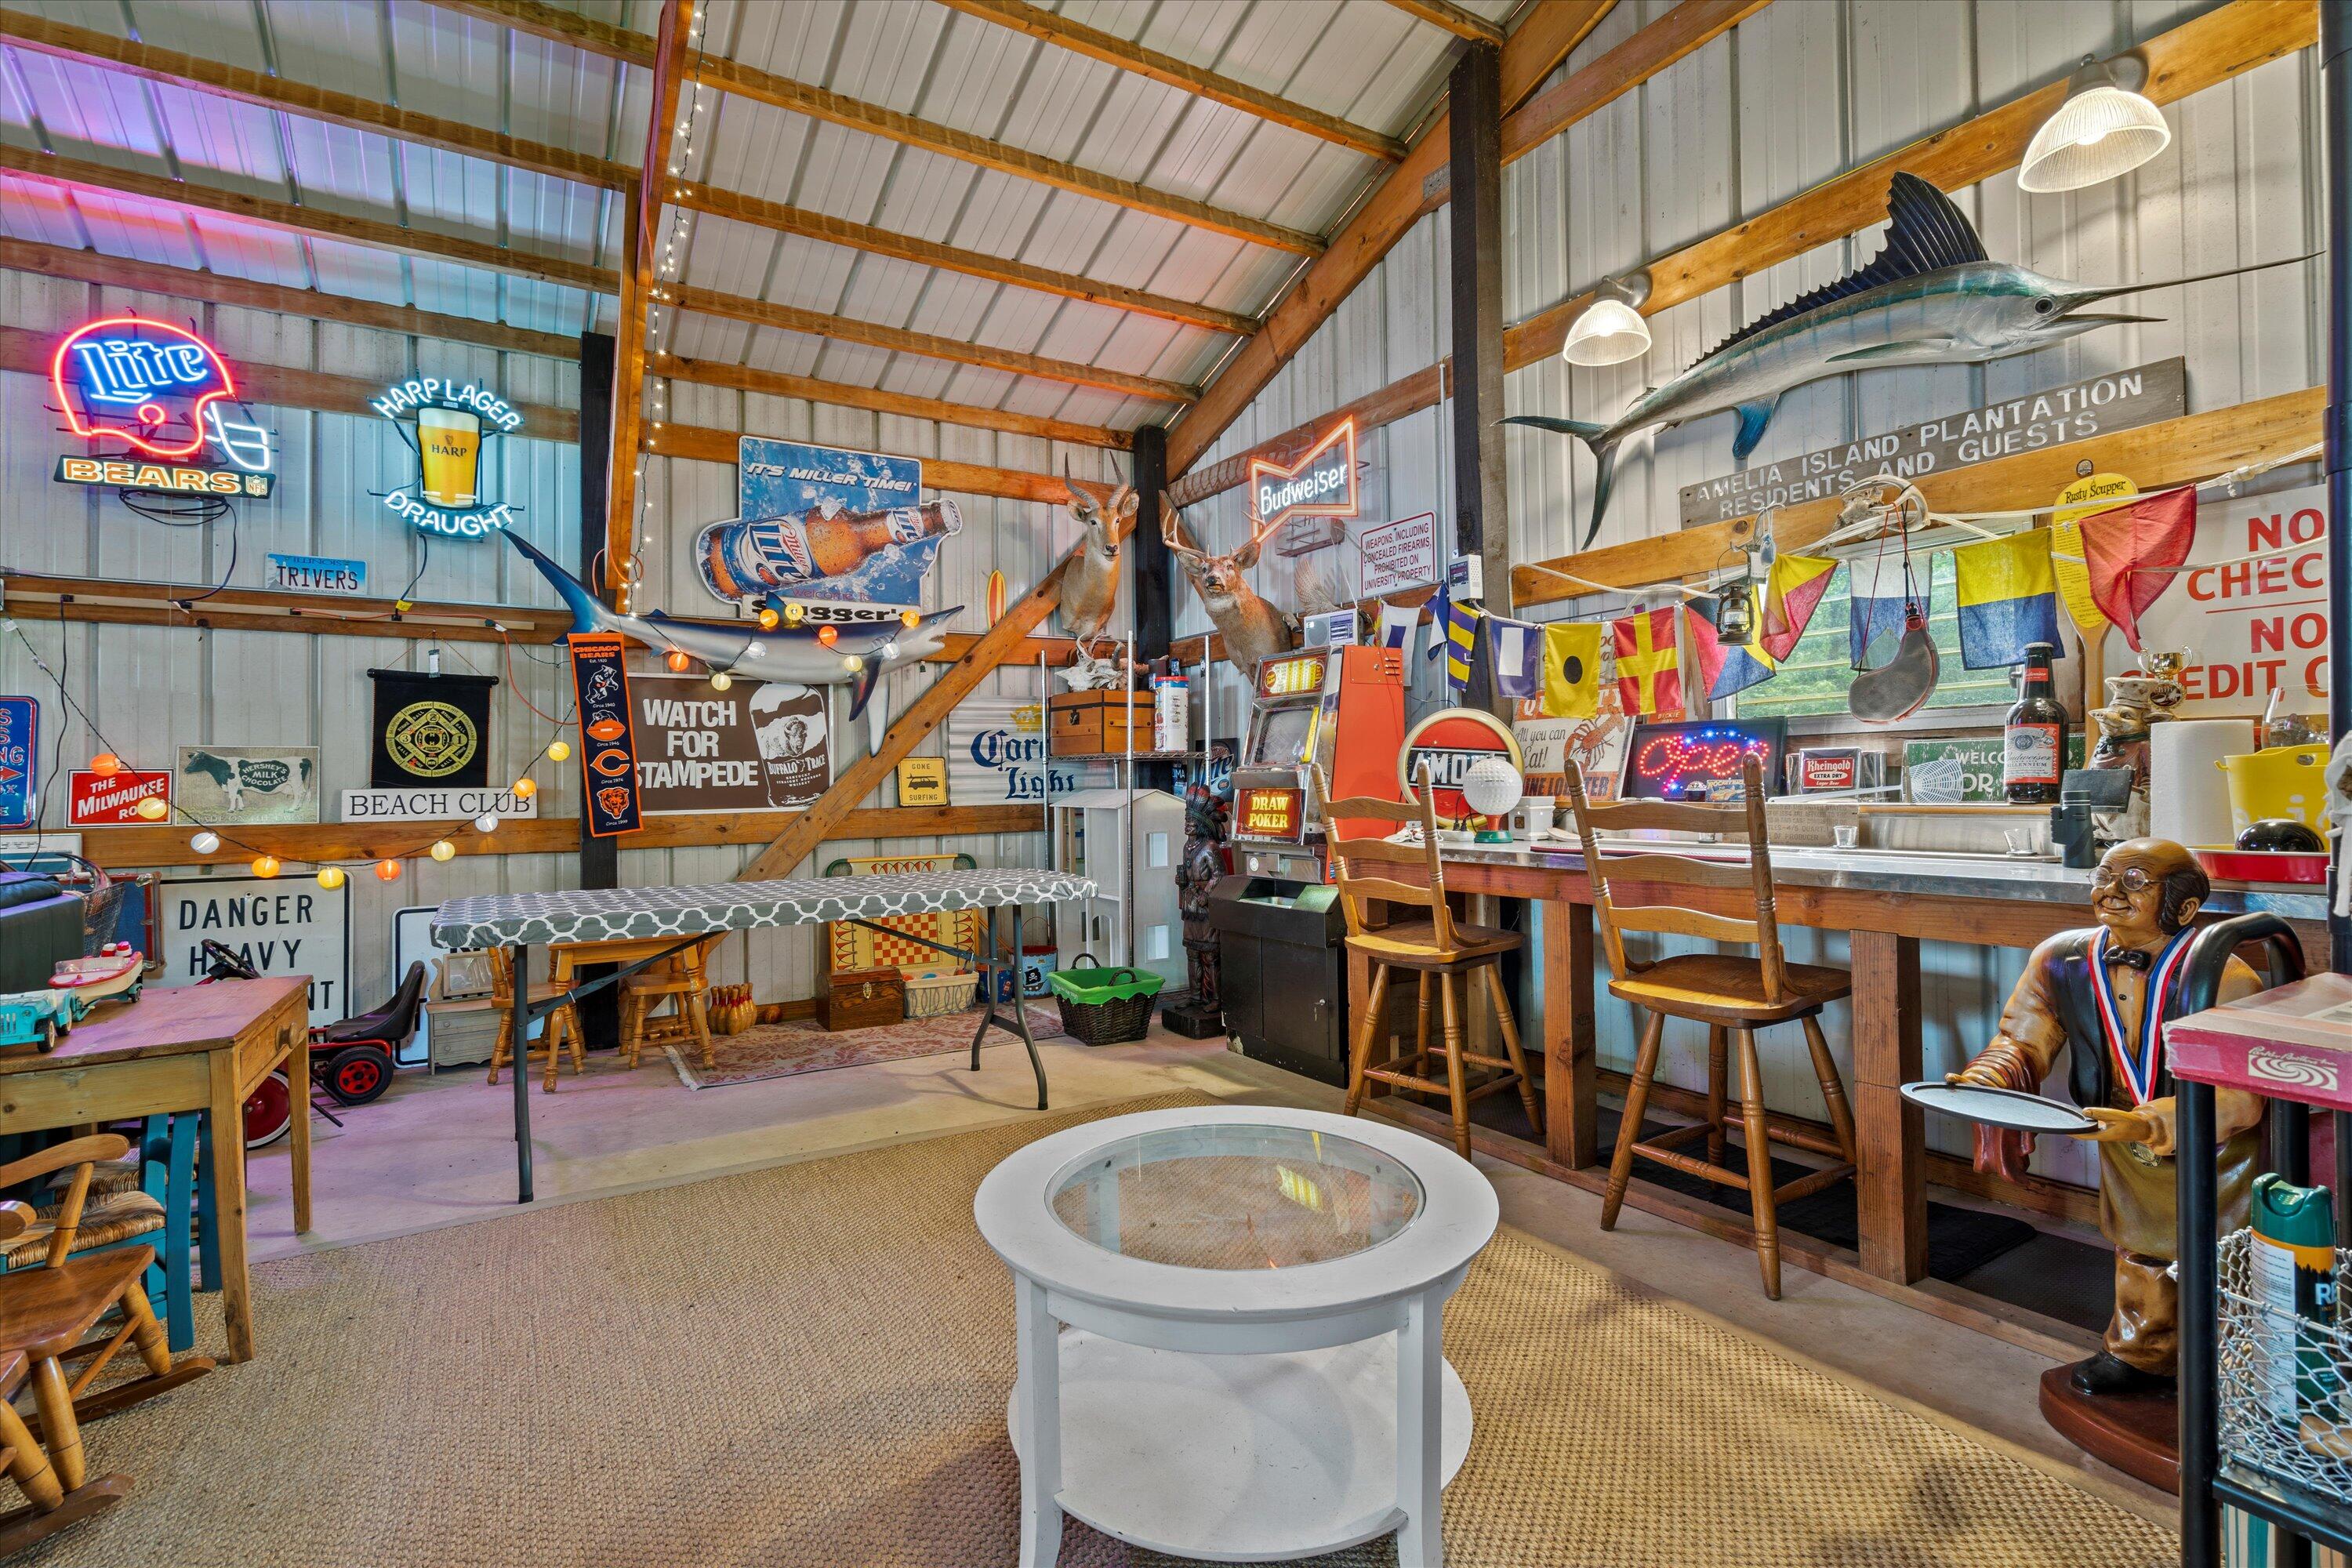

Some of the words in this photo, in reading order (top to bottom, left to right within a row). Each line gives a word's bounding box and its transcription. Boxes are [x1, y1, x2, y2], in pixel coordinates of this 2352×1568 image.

[372, 379, 439, 419] HARP
[446, 379, 521, 430] LAGER
[1697, 464, 1782, 502] AMELIA
[1802, 433, 1900, 477] ISLAND
[1921, 371, 2143, 447] PLANTATION
[431, 445, 467, 458] HARP
[1719, 470, 1856, 518] RESIDENTS
[1878, 452, 1935, 478] AND
[1958, 411, 2099, 463] GUESTS
[64, 458, 241, 494] BEARS
[249, 482, 266, 494] NFL
[747, 463, 786, 477] IT'S
[789, 467, 859, 486] MILLER
[863, 475, 914, 492] TIME!
[1261, 463, 1348, 515] Budweiser
[2064, 488, 2088, 504] Rusty
[2089, 481, 2126, 498] Scupper
[384, 492, 514, 535] DRAUGHT
[1396, 523, 1429, 541] INCLUDING
[2248, 509, 2325, 552] NO
[784, 527, 809, 569] Miller
[1363, 546, 1397, 564] CONCEALED
[1399, 537, 1432, 554] FIREARMS,
[277, 565, 358, 590] TRIVERS
[1365, 574, 1396, 590] UNIVERSITY
[1397, 564, 1432, 581] PROPERTY
[1374, 557, 1408, 575] PROHIBITED
[1410, 554, 1419, 564] ON
[2187, 553, 2324, 601] CHEC
[792, 588, 853, 601] Welcome
[2250, 612, 2328, 653] NO
[2118, 659, 2287, 701] EDIT
[643, 699, 737, 728] WATCH
[401, 735, 408, 743] 3
[667, 731, 719, 757] FOR
[1515, 727, 1530, 741] All
[1530, 731, 1548, 746] you
[1549, 729, 1566, 740] can
[241, 763, 287, 774] HERSHEY'S
[767, 761, 798, 775] BUFFALO
[804, 753, 826, 771] TRACE
[1410, 751, 1490, 785] AMO
[1806, 760, 1851, 771] Rheingold
[1955, 751, 2005, 764] WELCO
[90, 778, 117, 793] THE
[241, 775, 288, 786] CHOCOLATE
[1004, 767, 1076, 800] Light
[77, 778, 165, 818] MILWAUKEE
[350, 793, 448, 816] BEACH
[459, 792, 530, 813] CLUB
[1252, 797, 1289, 811] DRAW
[1249, 814, 1288, 828] POKER
[180, 895, 313, 931] DANGER
